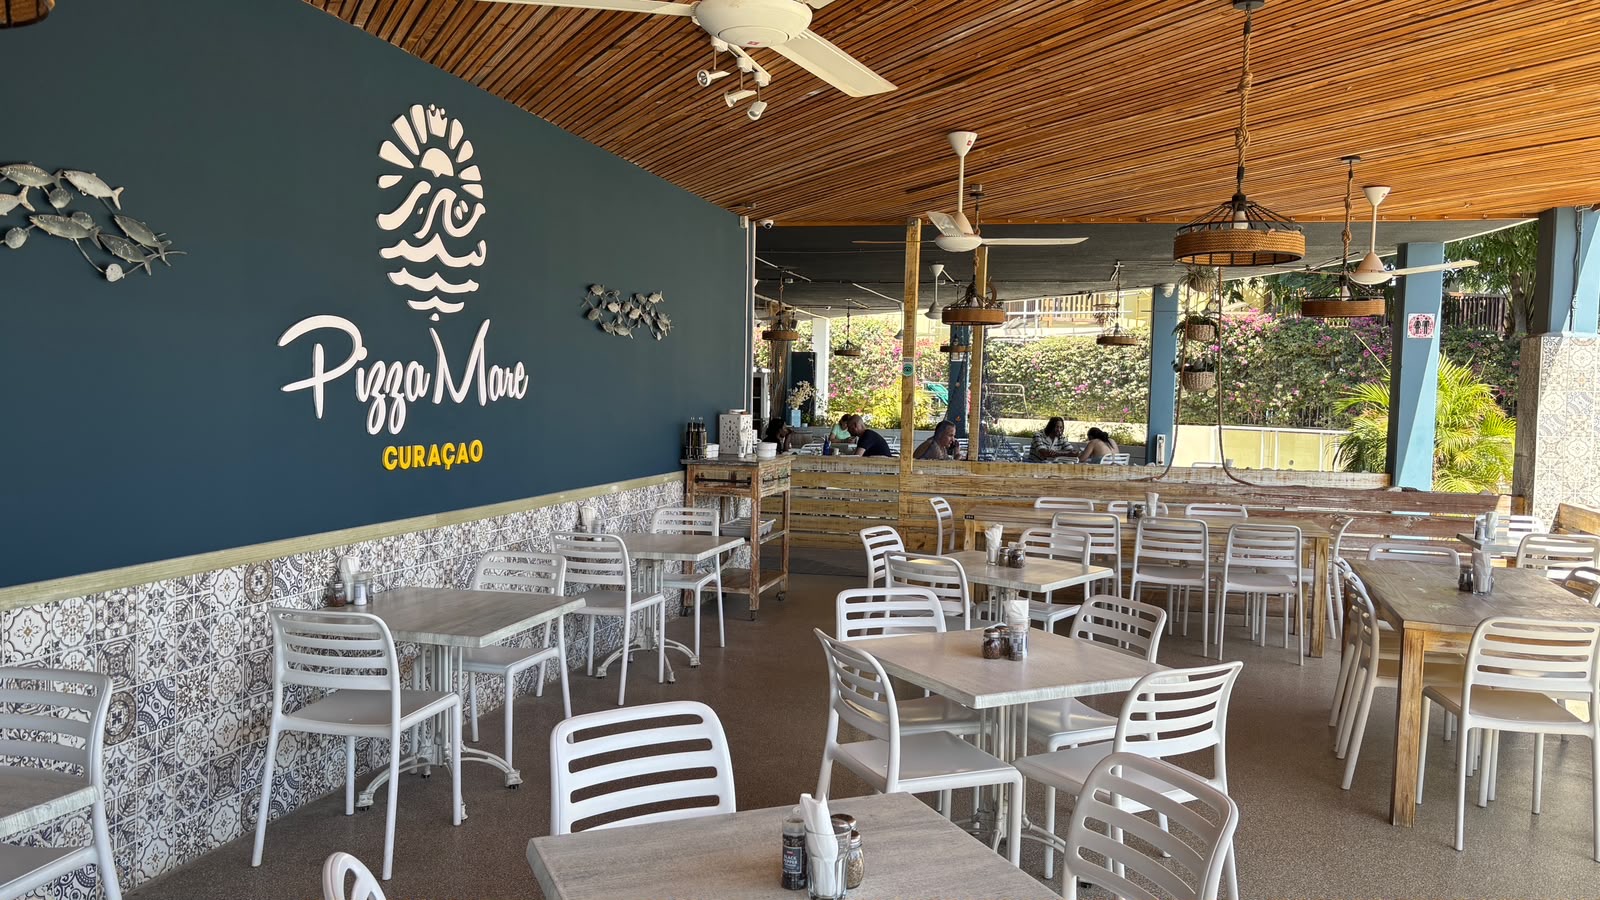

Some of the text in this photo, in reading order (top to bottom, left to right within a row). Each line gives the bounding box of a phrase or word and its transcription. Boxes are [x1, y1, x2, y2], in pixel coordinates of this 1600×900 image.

[277, 314, 529, 435] Pizza Mare
[381, 439, 484, 471] CURAÇAO
